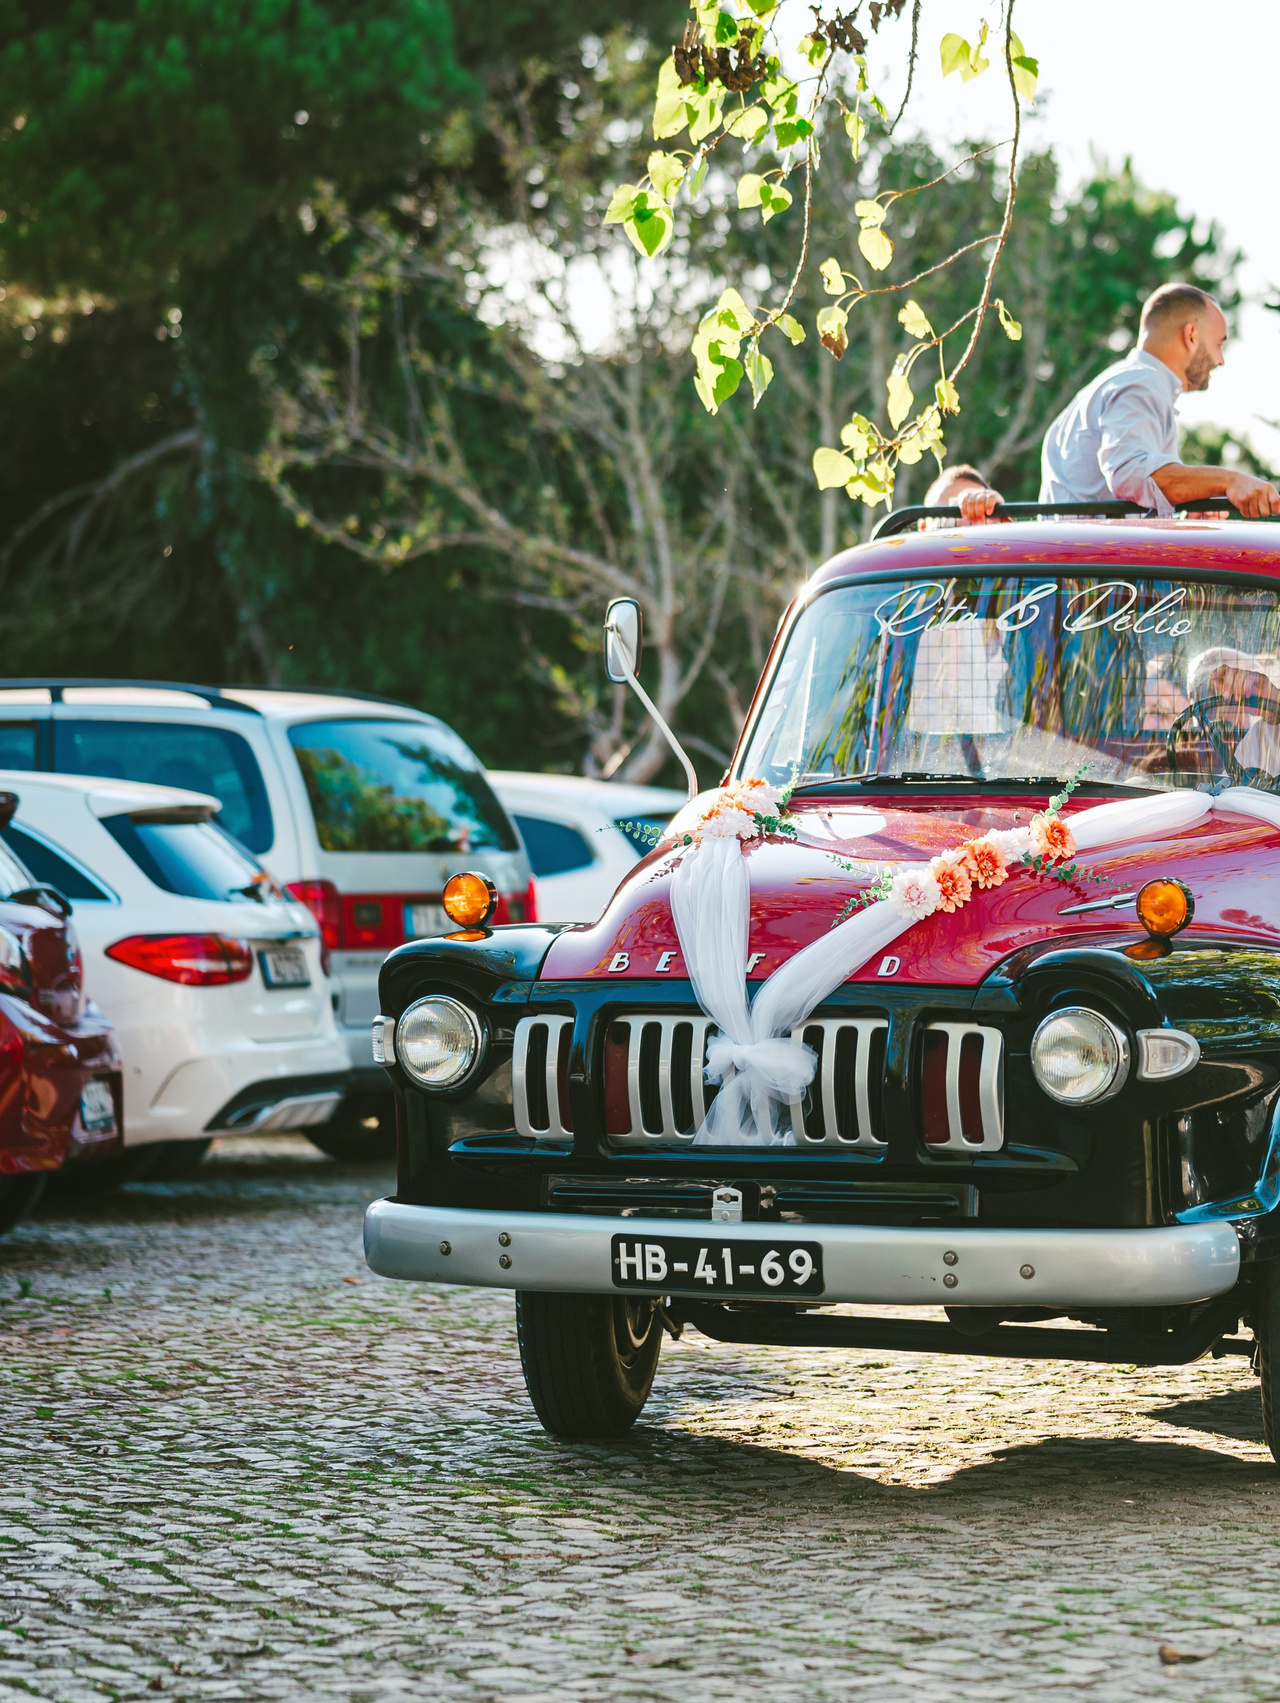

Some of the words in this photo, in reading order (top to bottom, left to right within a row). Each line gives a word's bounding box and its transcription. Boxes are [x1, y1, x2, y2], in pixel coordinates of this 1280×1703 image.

[874, 583, 984, 637] Rita
[996, 583, 1058, 632] &
[1063, 582, 1192, 637] Délio
[608, 952, 901, 977] BEFD
[619, 1242, 814, 1287] HB-41-69
